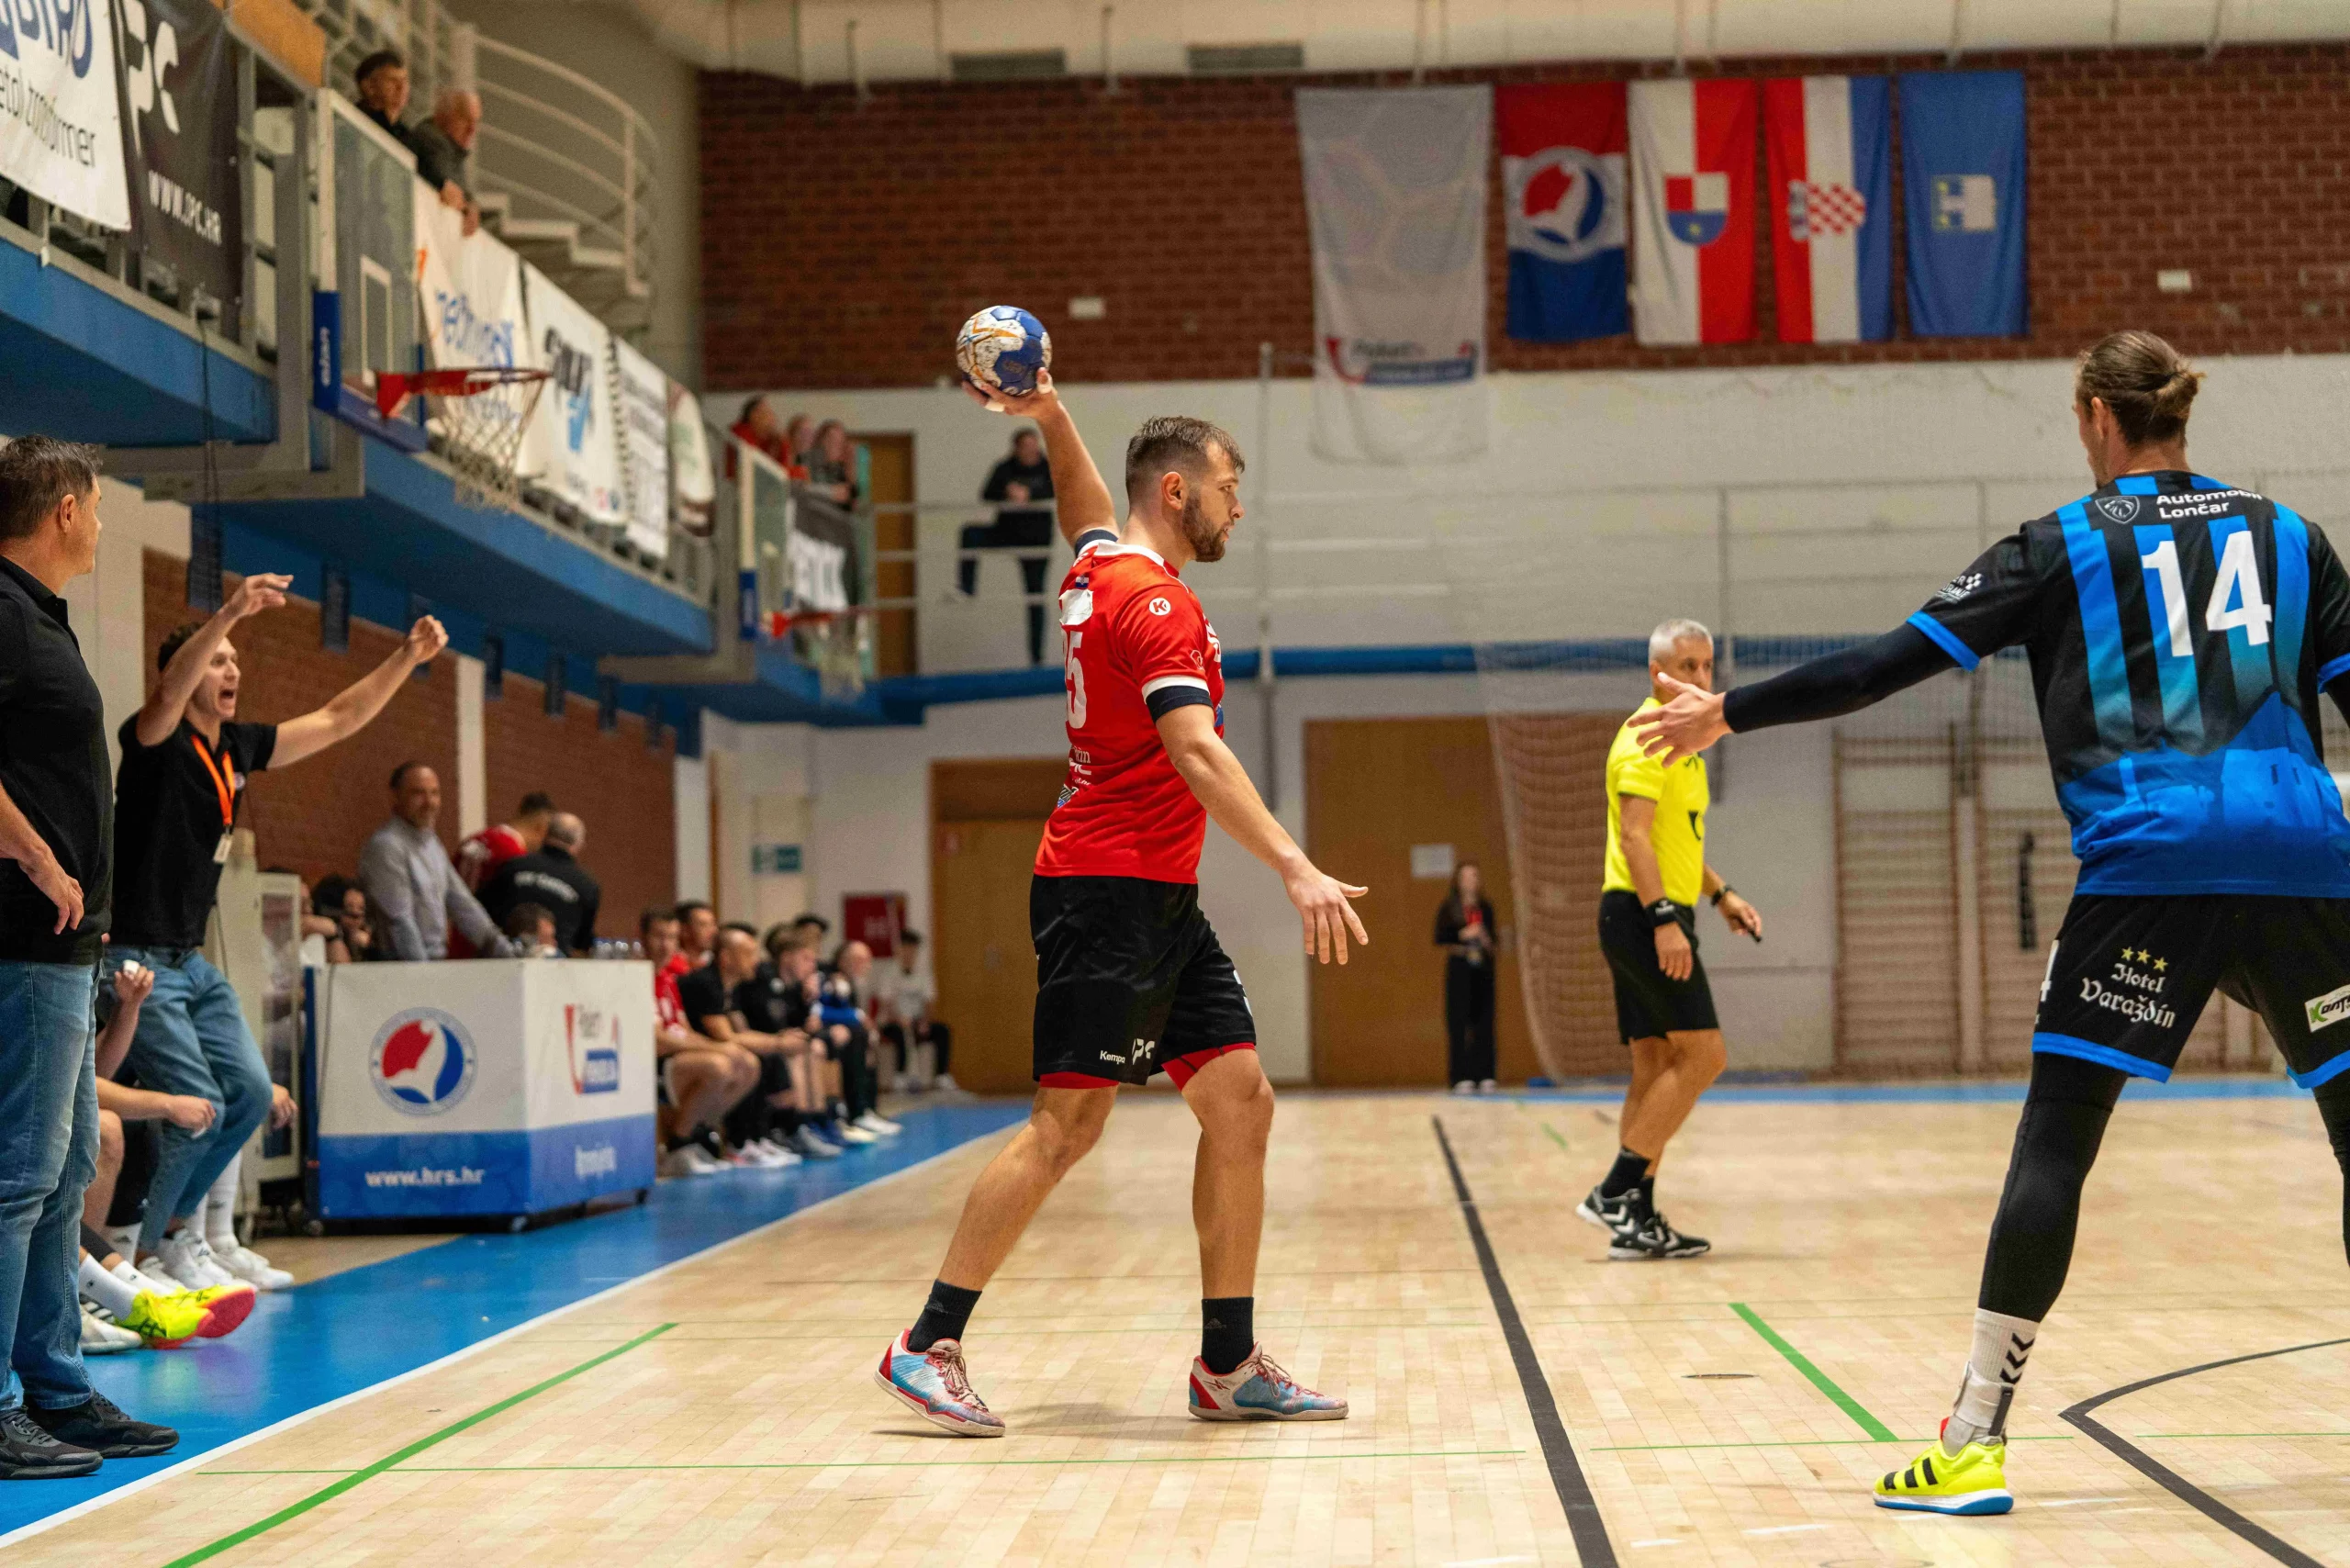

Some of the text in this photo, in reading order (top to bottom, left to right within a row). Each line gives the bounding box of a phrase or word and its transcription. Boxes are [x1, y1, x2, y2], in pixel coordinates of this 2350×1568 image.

[2159, 502, 2230, 520] Lončar
[2142, 530, 2273, 657] 14
[2110, 962, 2166, 994] Hotel
[1100, 1050, 1125, 1064] Kempa
[364, 1166, 486, 1188] www.hrs.hr
